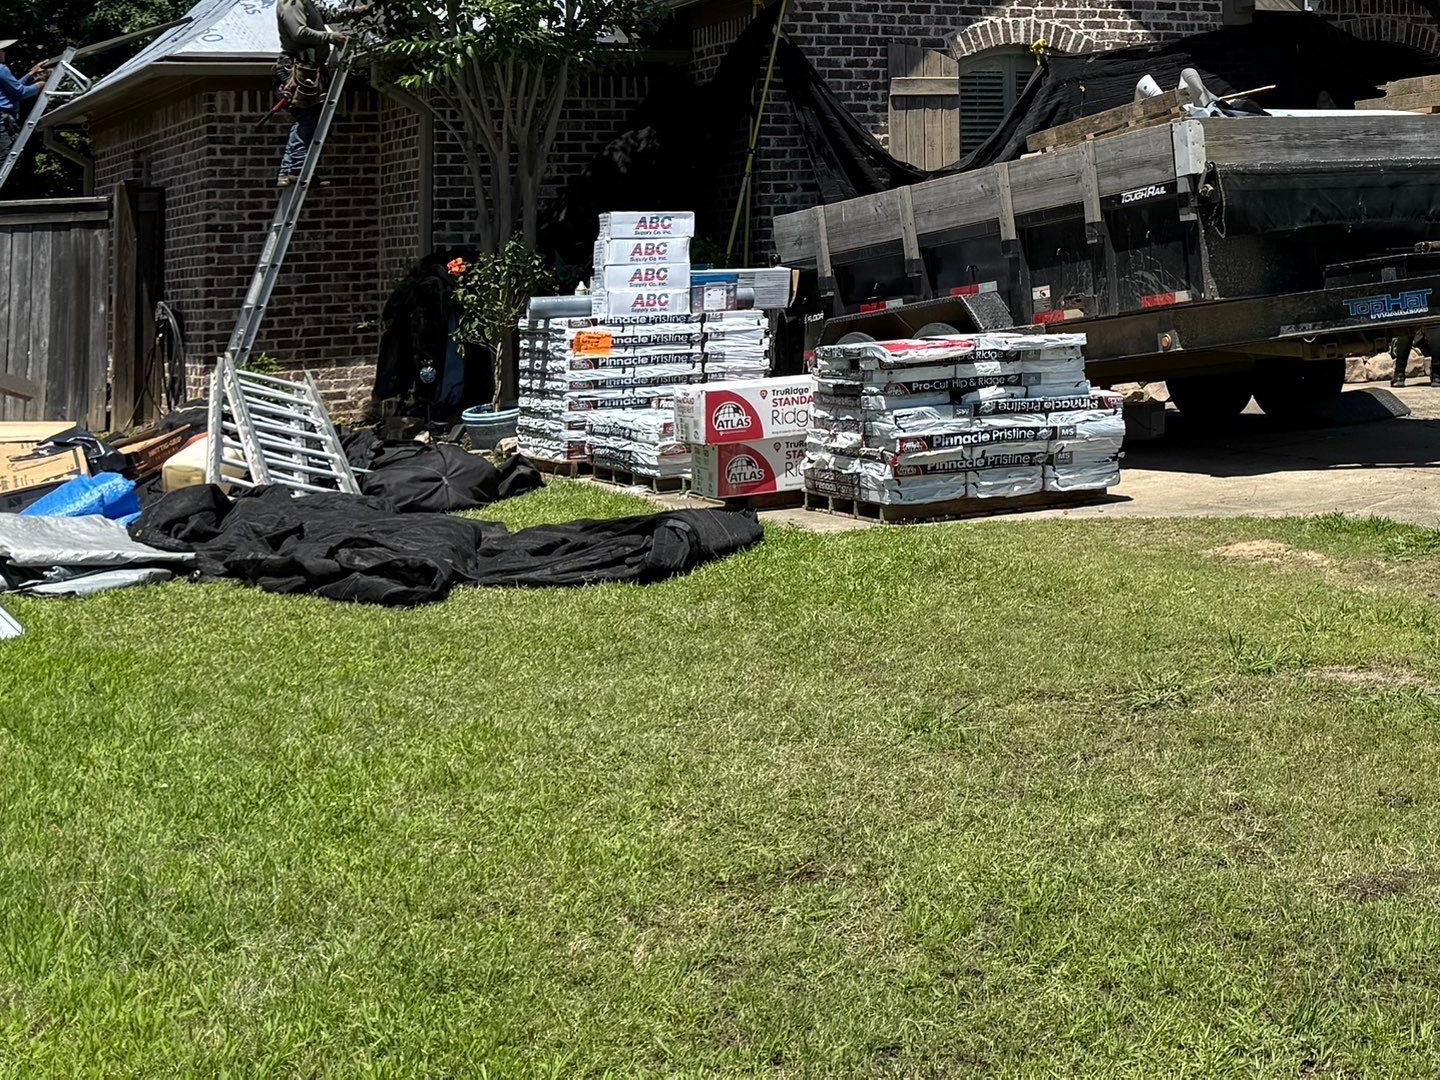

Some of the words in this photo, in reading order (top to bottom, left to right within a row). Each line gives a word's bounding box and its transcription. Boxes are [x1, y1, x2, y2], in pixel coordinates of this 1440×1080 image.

[633, 215, 674, 230] ABC
[629, 242, 670, 256] ABC
[628, 267, 670, 282] ABC
[631, 292, 671, 307] ABC
[598, 316, 648, 324] Pinnacle
[649, 314, 687, 324] Pristine
[650, 334, 688, 343] Pristine
[598, 356, 649, 366] Pinnacle
[650, 354, 688, 364] Pristine
[975, 348, 1004, 361] Ridge
[598, 377, 648, 386] Pinnacle
[649, 375, 688, 385] Pristine
[911, 380, 949, 392] Pro-Cut
[951, 377, 967, 389] Hip
[968, 377, 977, 387] &
[977, 375, 1006, 388] Ridge
[771, 386, 810, 397] TruRidge
[597, 397, 648, 407] Pinnacle
[771, 395, 816, 408] STANDA
[998, 400, 1043, 413] Pristine
[1043, 395, 1099, 409] Pinnacle
[716, 417, 751, 430] ATLAS
[932, 431, 991, 448] Pinnacle
[991, 426, 1036, 441] Pristine
[1061, 428, 1075, 437] MS
[927, 456, 985, 471] Pinnacle
[986, 453, 1031, 466] Pristine
[1058, 452, 1071, 461] MS
[729, 469, 764, 483] ATLAS
